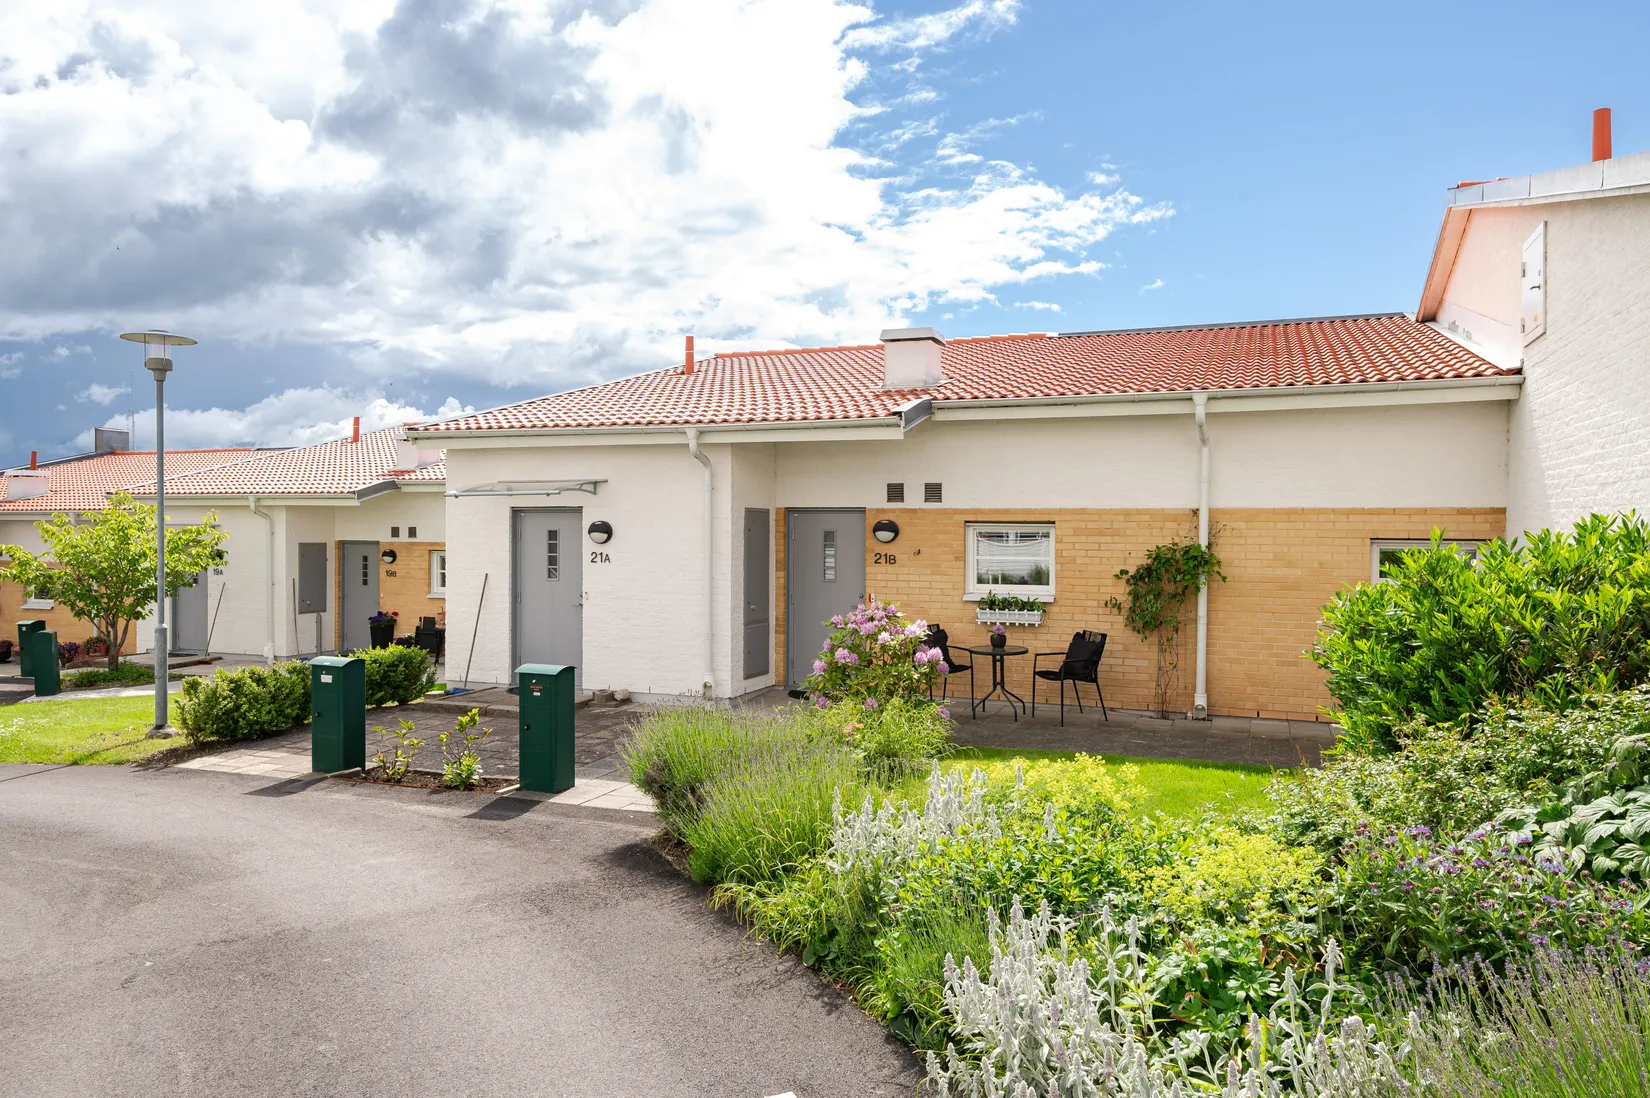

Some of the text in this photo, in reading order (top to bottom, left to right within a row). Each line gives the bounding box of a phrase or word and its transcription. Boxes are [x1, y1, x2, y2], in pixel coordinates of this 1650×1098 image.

[590, 551, 611, 564] 21A
[874, 552, 896, 565] 21B
[213, 567, 224, 576] 19A
[385, 569, 397, 578] 19B
